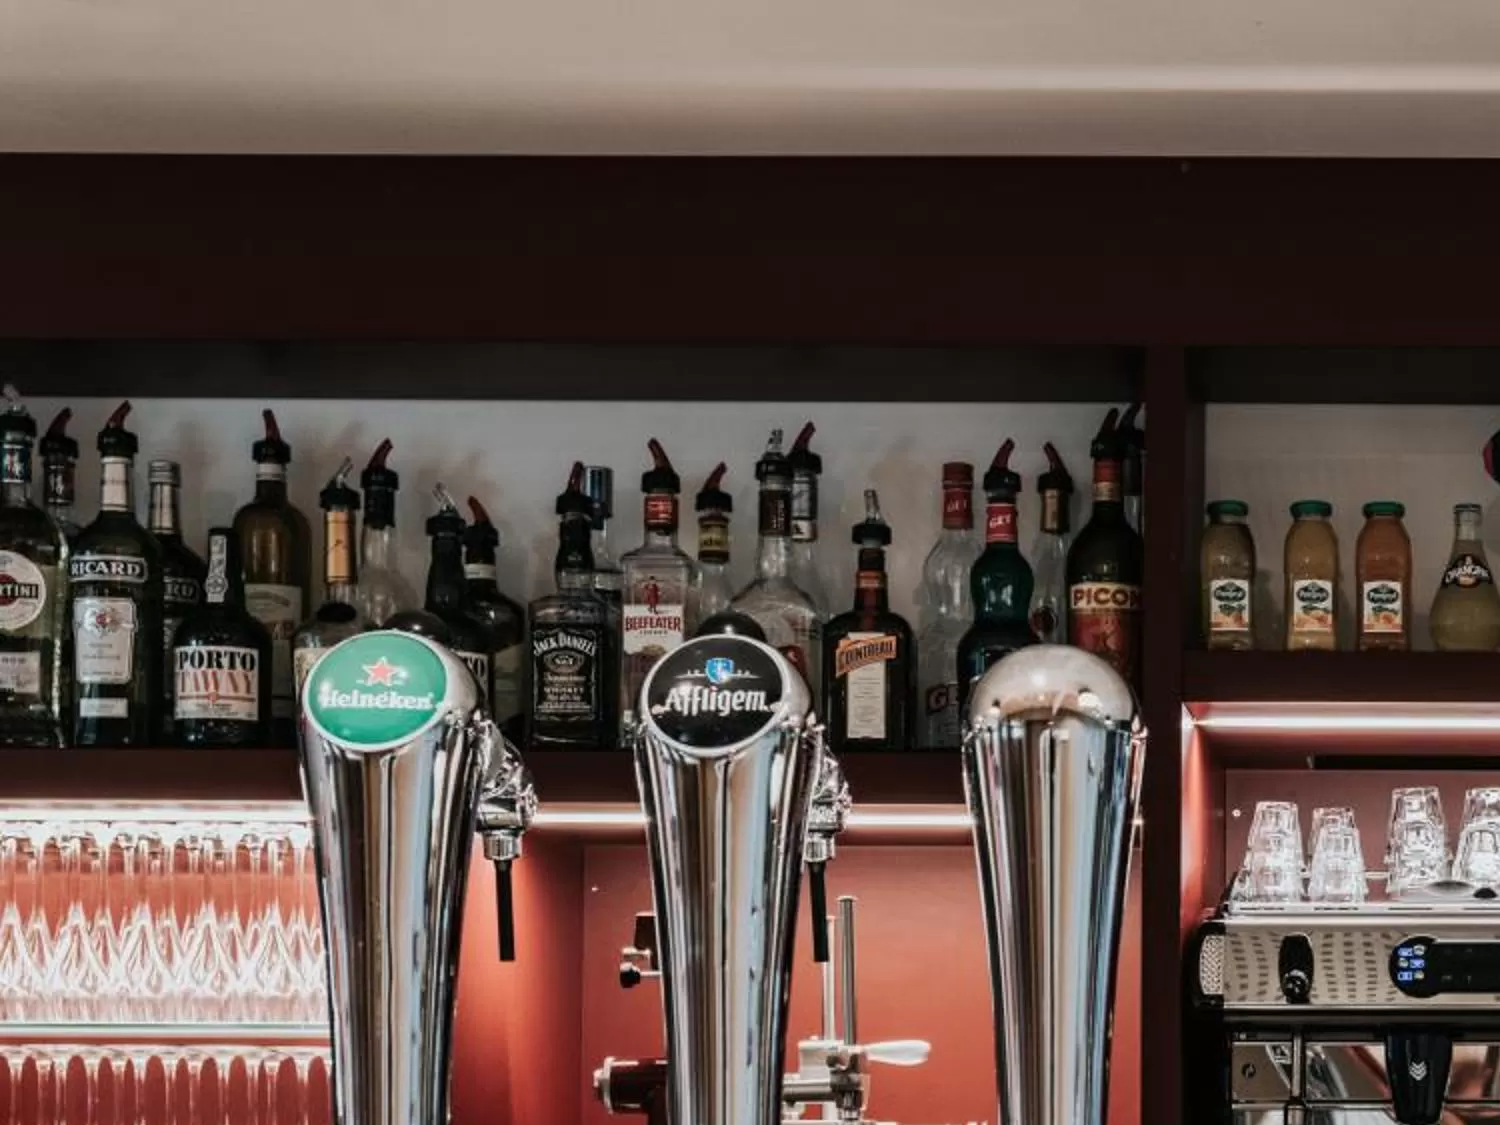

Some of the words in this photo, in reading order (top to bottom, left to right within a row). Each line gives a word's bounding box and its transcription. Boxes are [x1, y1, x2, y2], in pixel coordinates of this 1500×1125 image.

[71, 561, 141, 576] RICARD
[625, 615, 681, 632] BEEFEATER
[178, 651, 256, 671] PORTO
[179, 670, 252, 694] TAWNY
[319, 682, 433, 709] Heineken
[665, 683, 768, 717] Affligem
